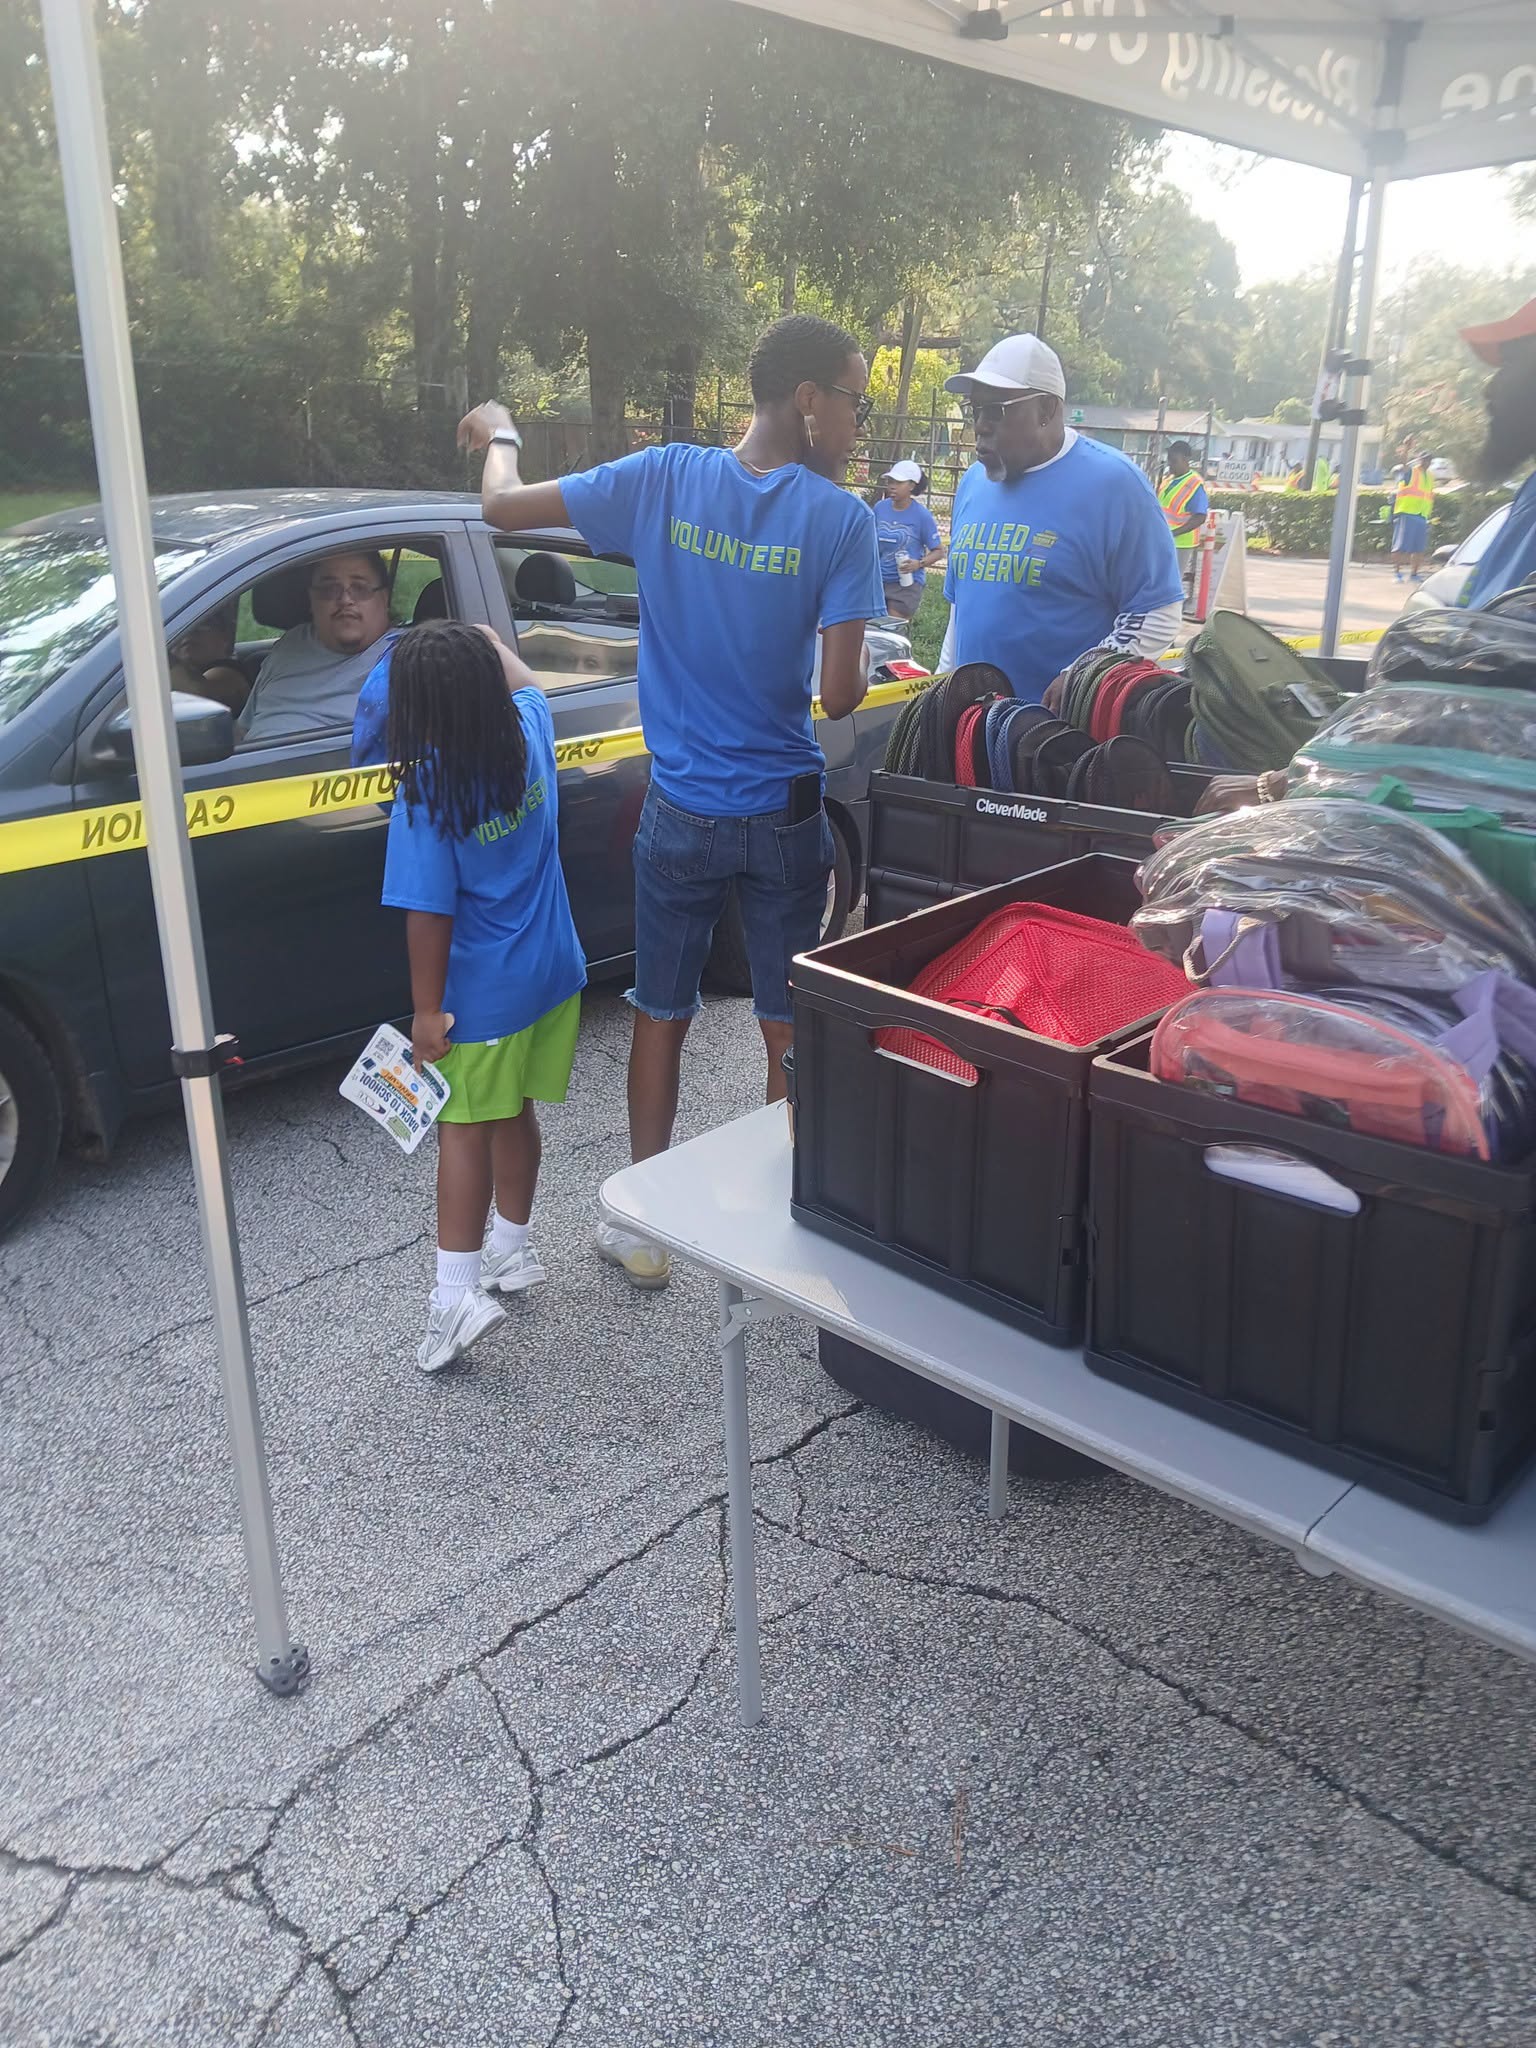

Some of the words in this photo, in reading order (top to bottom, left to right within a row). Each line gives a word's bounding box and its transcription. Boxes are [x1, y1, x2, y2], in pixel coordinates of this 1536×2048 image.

[1219, 471, 1250, 480] CLOSED
[1224, 462, 1247, 471] ROAD
[670, 515, 801, 576] VOLUNTEER
[954, 522, 1031, 552] CALLED
[950, 552, 969, 580] TO
[972, 552, 1047, 587] SERVE
[976, 798, 1047, 822] CleverMade
[359, 1072, 391, 1102] SCHOOL
[389, 1098, 402, 1112] TO
[398, 1108, 420, 1133] BACK
